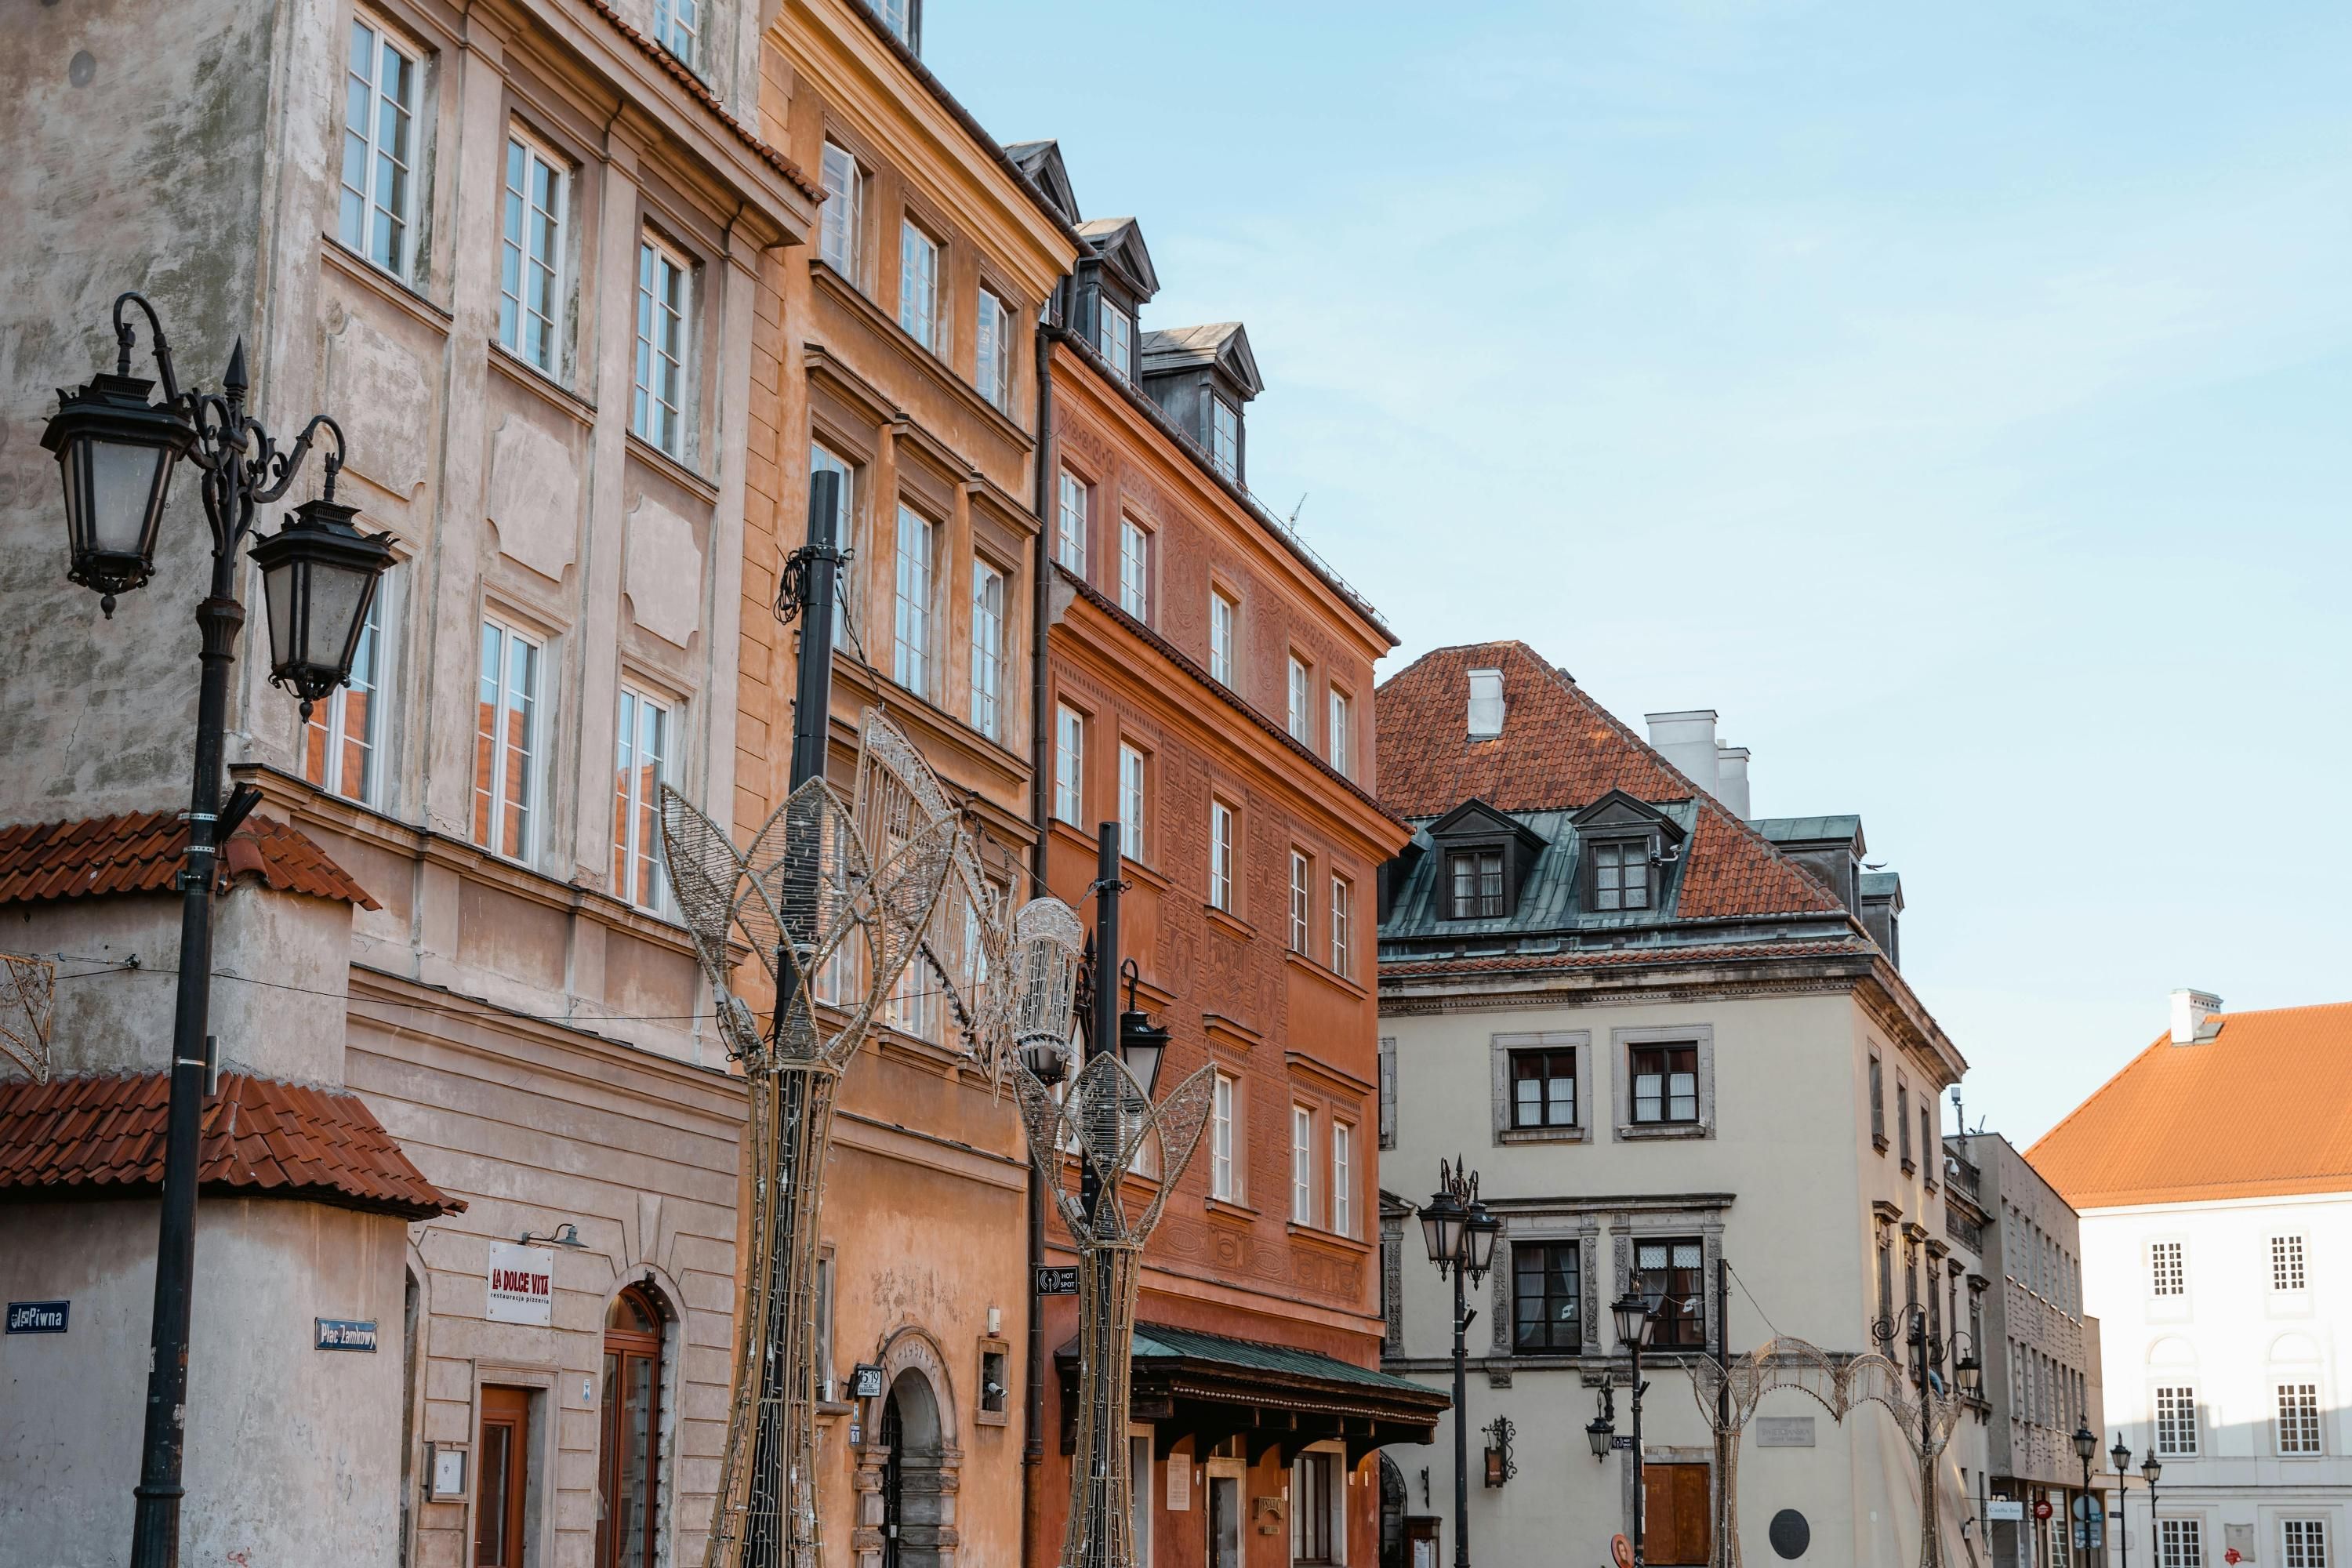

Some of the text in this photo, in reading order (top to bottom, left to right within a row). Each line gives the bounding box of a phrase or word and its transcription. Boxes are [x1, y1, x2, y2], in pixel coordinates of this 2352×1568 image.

[492, 1269, 549, 1295] LA DOLCE VITA
[490, 1293, 524, 1302] restauracja
[28, 1307, 63, 1327] Piwna
[321, 1323, 376, 1349] Plac Zamkowy
